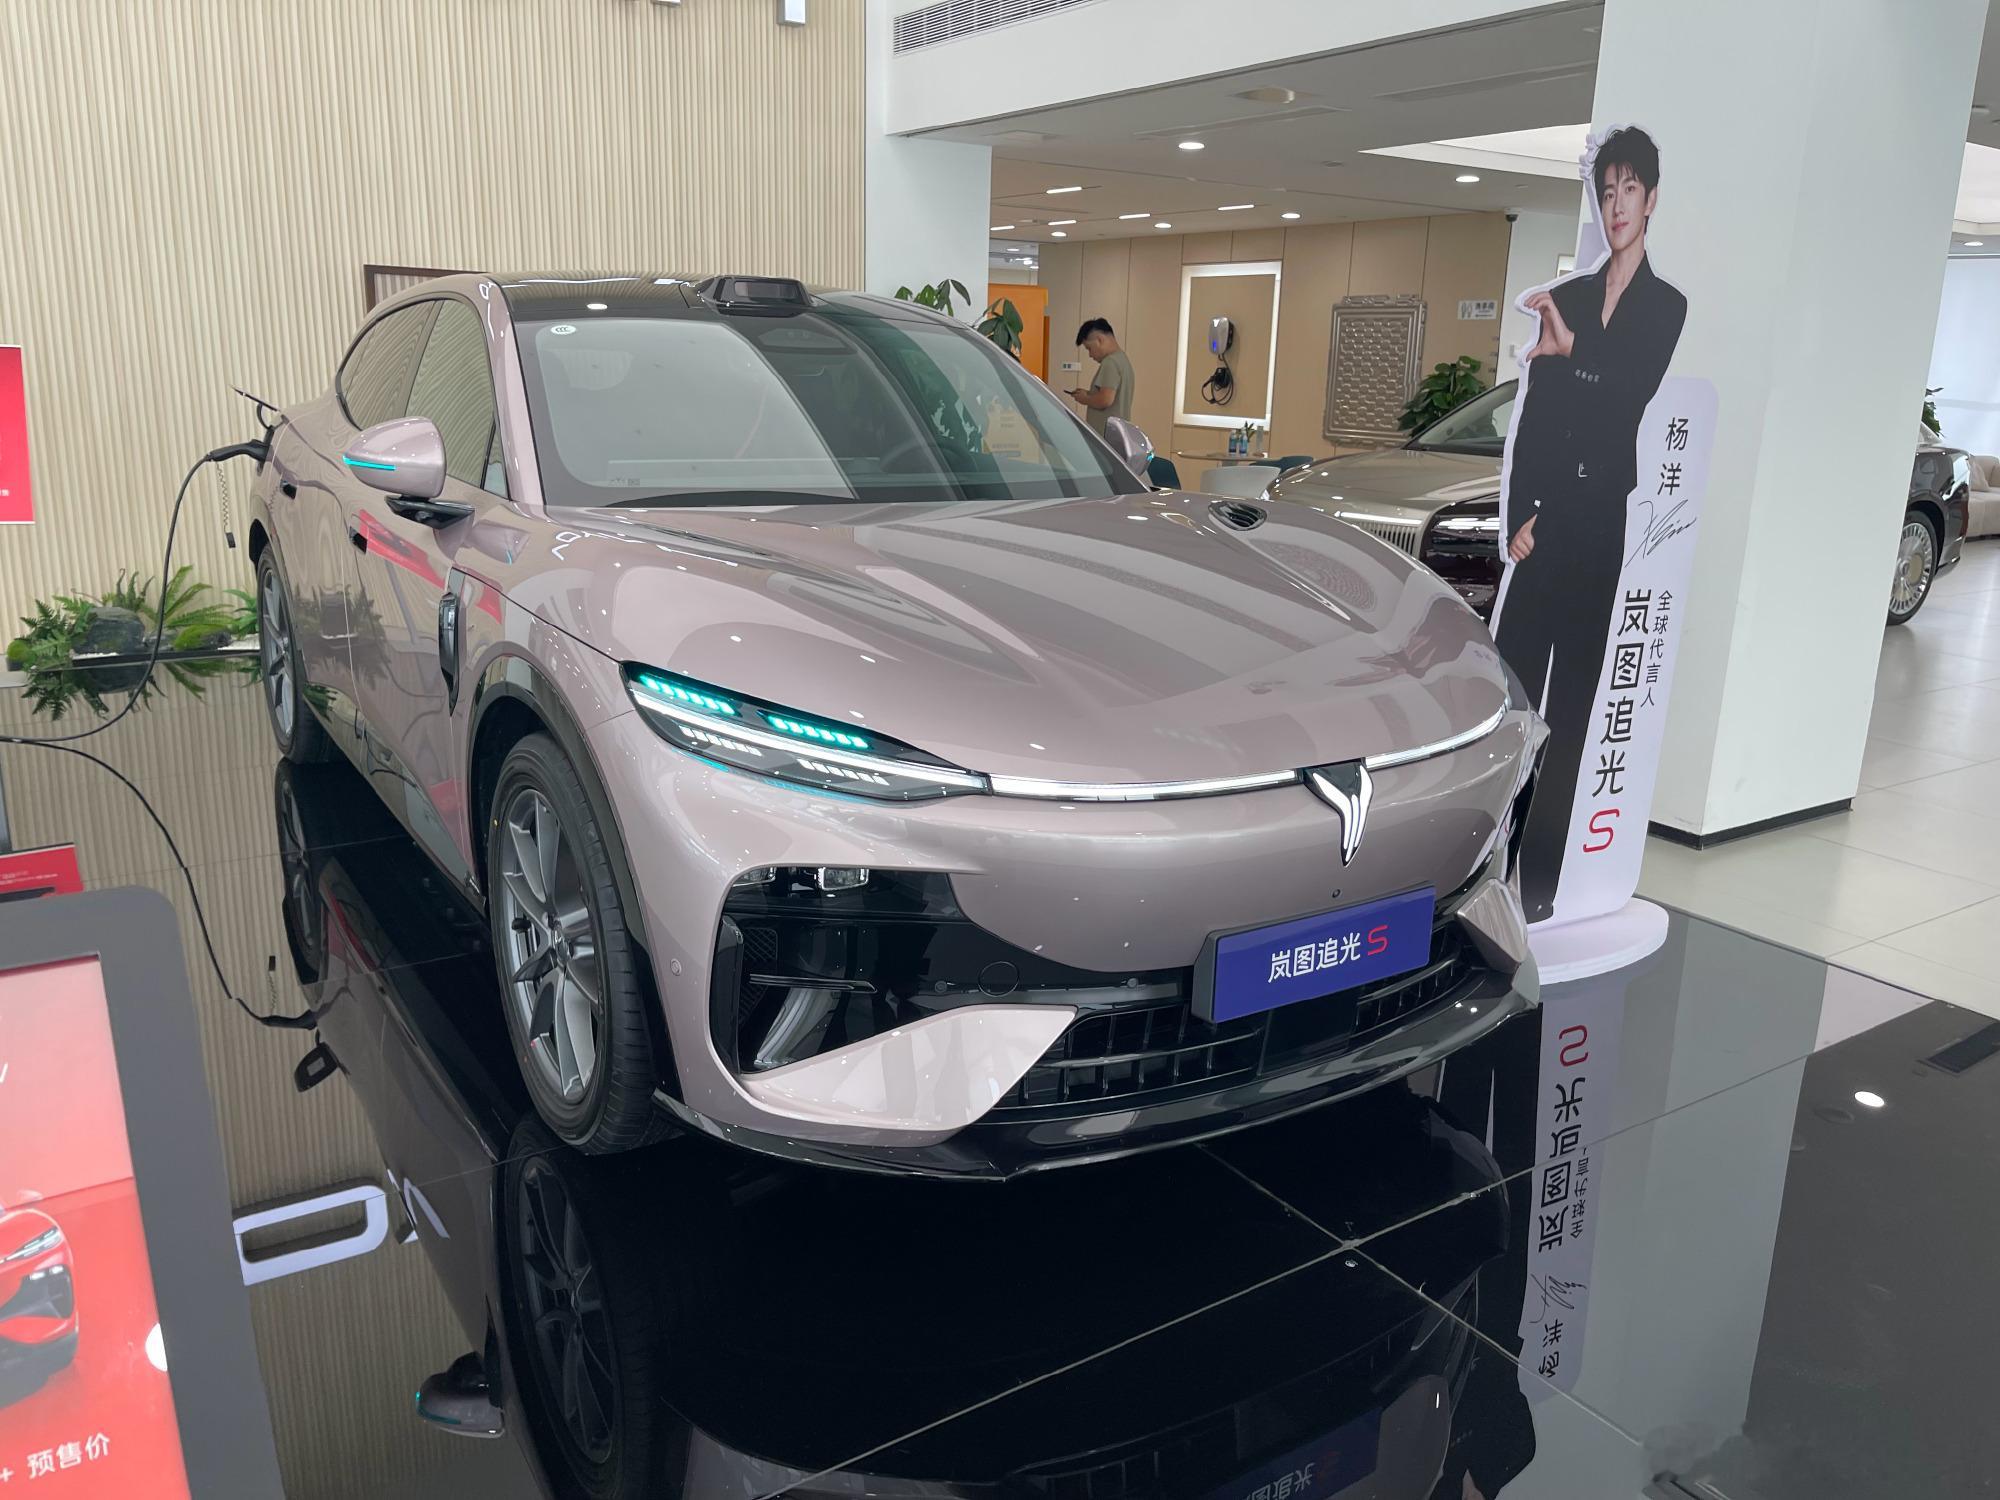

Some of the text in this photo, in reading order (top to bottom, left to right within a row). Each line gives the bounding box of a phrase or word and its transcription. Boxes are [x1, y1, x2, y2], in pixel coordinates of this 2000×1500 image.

[1657, 417, 1689, 496] 杨洋
[1640, 590, 1673, 707] 全球代言人
[27, 1432, 110, 1479] 预售价
